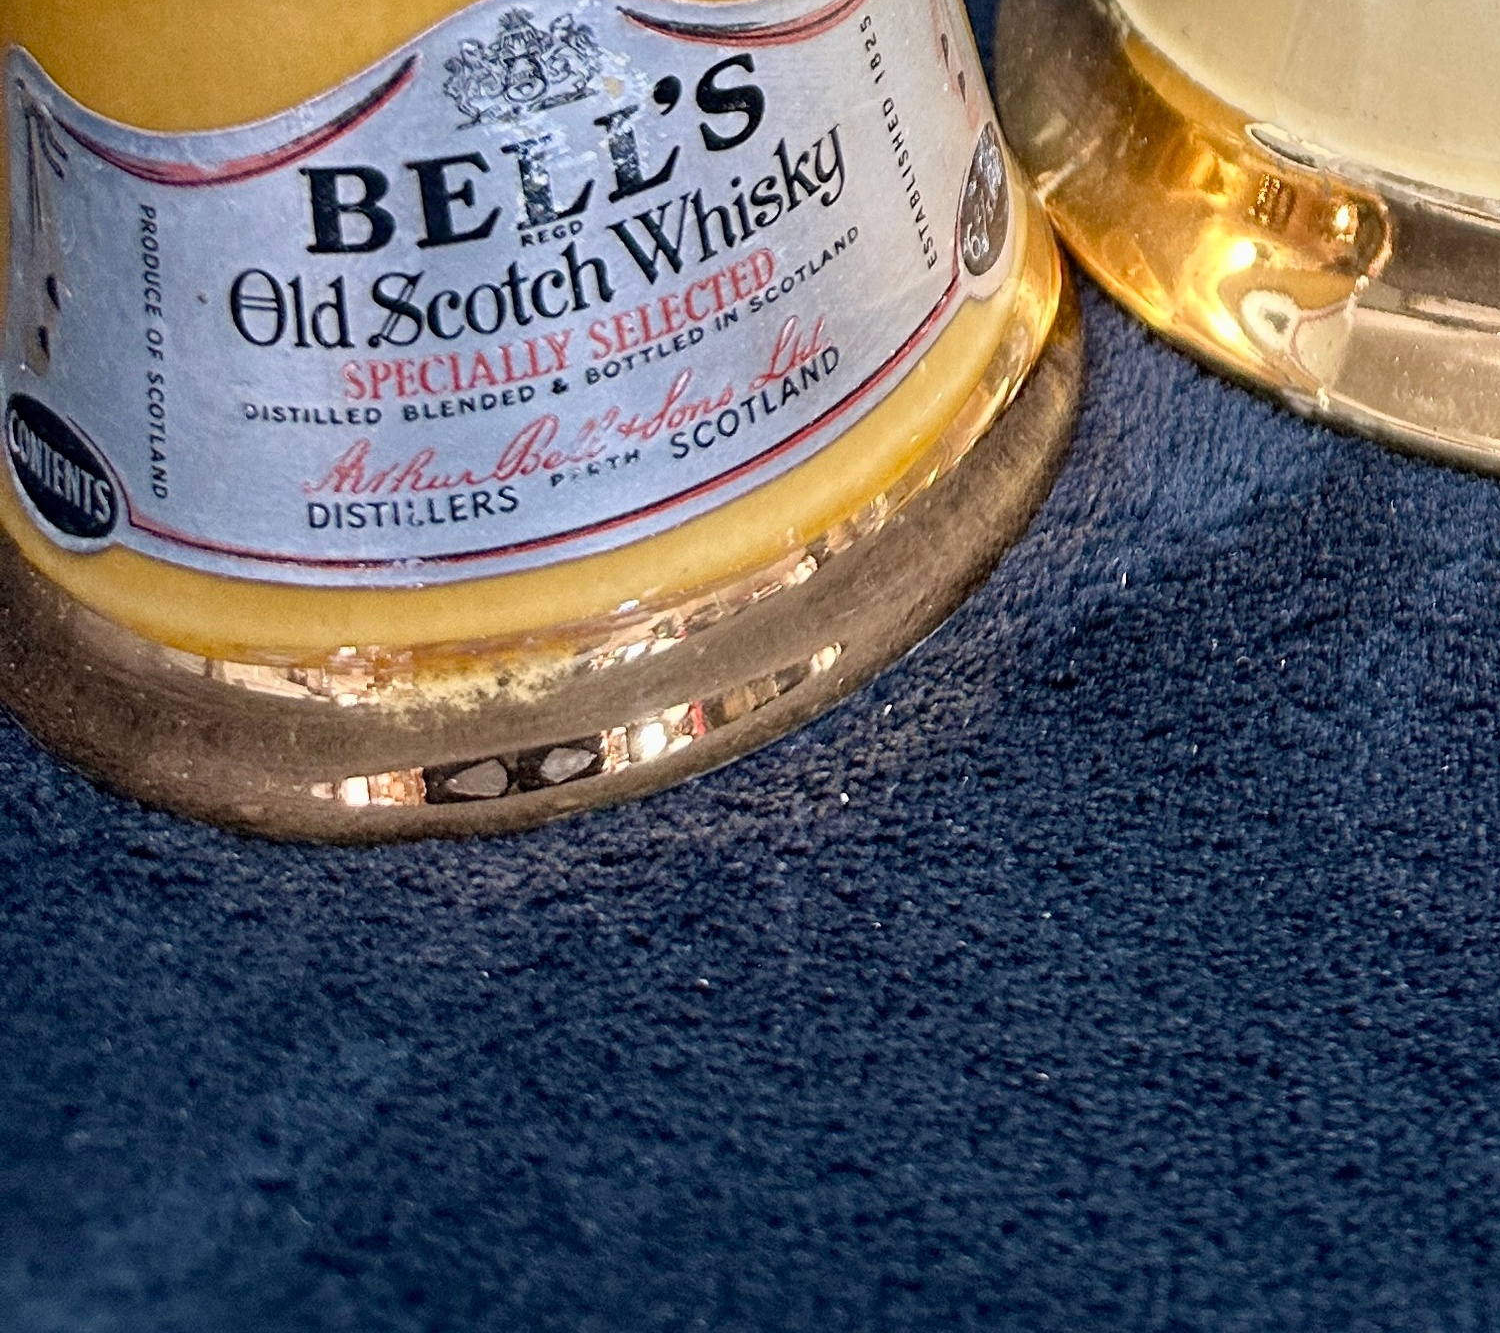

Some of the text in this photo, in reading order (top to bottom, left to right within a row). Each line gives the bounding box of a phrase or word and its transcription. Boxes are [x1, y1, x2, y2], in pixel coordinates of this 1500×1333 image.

[229, 267, 356, 349] Old
[367, 240, 617, 349] Scotch
[606, 122, 847, 286] Whisky
[297, 51, 766, 255] BELL'S
[520, 220, 584, 248] REGD
[860, 14, 938, 270] ESTABLISHED 1825
[139, 202, 169, 500] PRODUCE OF SCOTLAND
[244, 225, 860, 426] DISTILLED BLENDED & BOTTLED IN SCOTLAND
[341, 246, 776, 402] SPECIALLY SELECTED
[668, 345, 841, 460] SCOTLAND
[8, 408, 112, 526] CONTENTS
